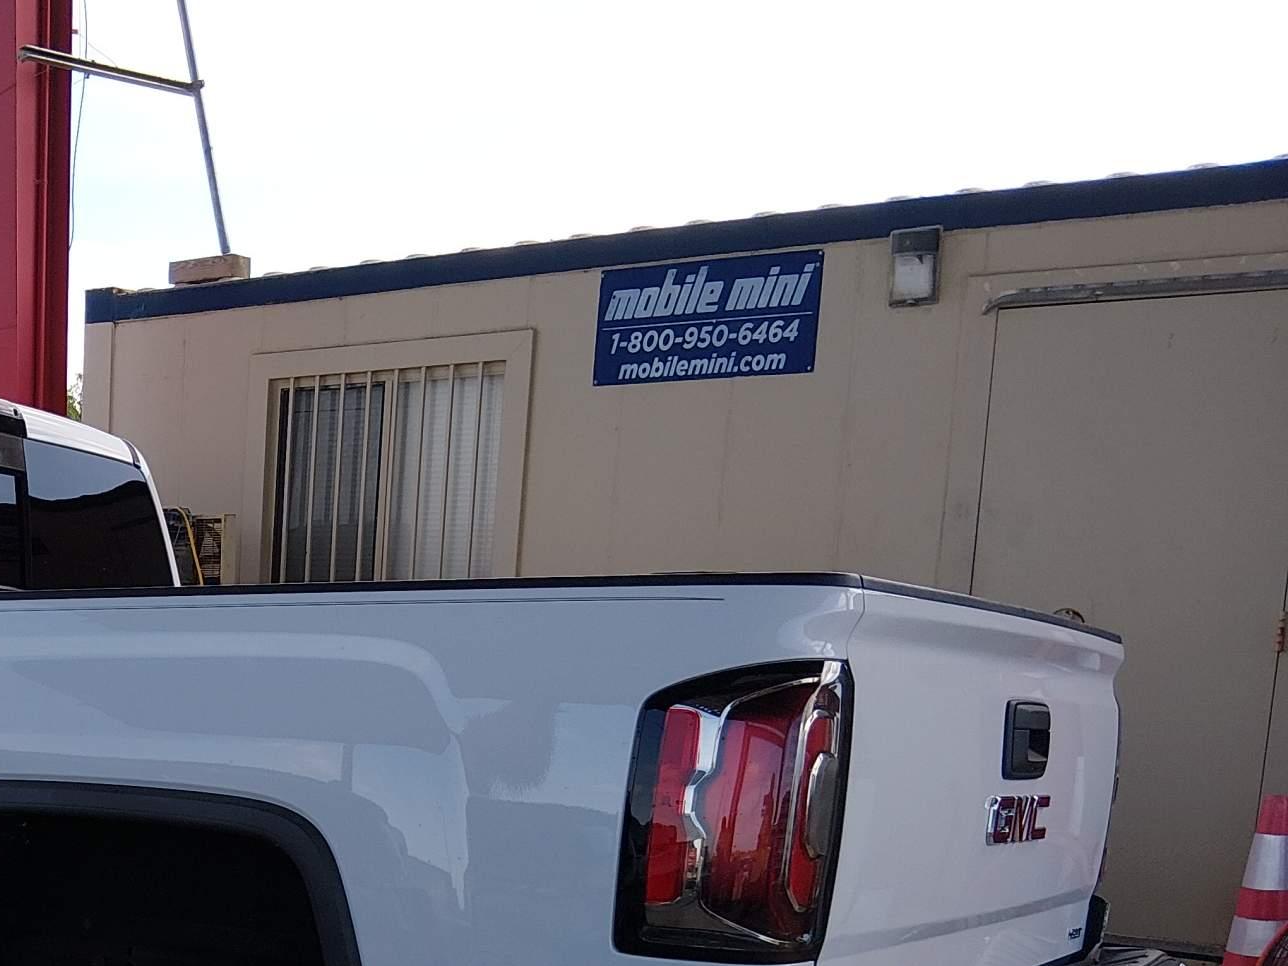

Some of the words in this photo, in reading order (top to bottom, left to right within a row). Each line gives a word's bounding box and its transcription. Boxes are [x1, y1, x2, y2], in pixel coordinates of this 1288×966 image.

[604, 265, 725, 321] mobile
[725, 263, 816, 312] mini
[611, 319, 801, 355] 1-800-950-6464
[618, 352, 787, 380] mobilemini.com
[985, 795, 1051, 846] GMC
